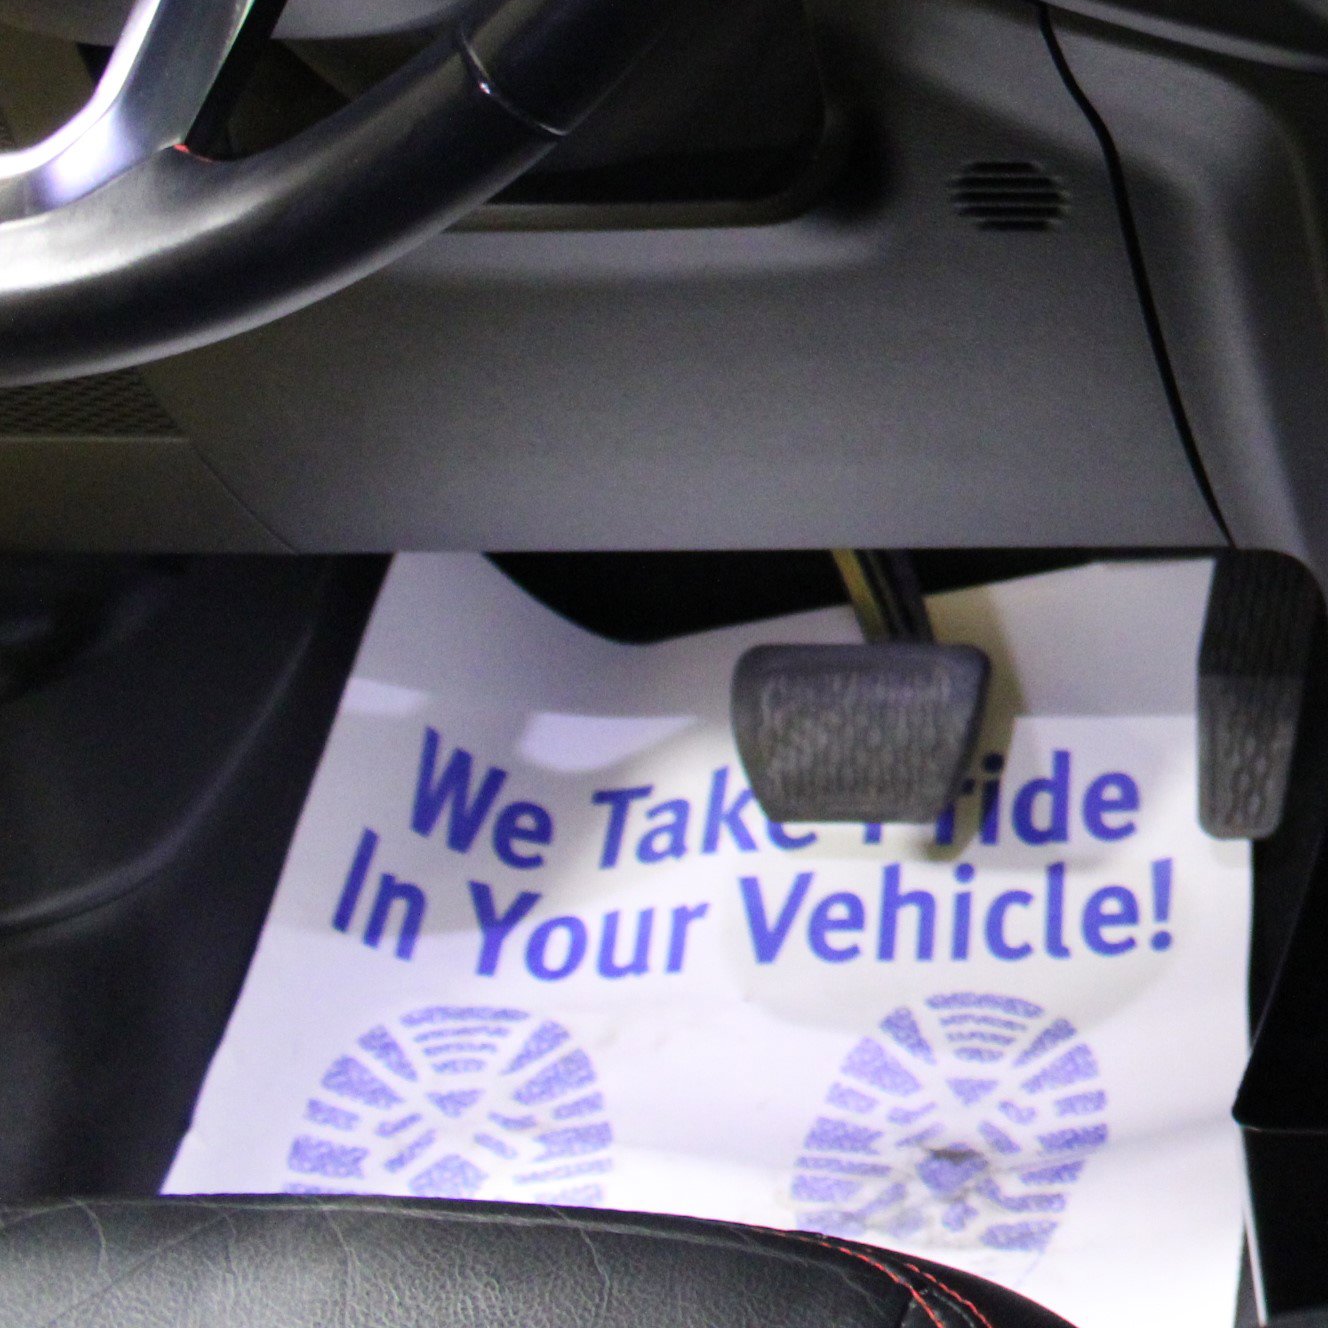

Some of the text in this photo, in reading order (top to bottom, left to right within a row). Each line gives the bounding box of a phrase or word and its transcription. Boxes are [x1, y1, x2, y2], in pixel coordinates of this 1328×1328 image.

[410, 725, 555, 870] We
[863, 748, 1140, 847] ride
[331, 827, 1177, 982] In Your Vehicle!
